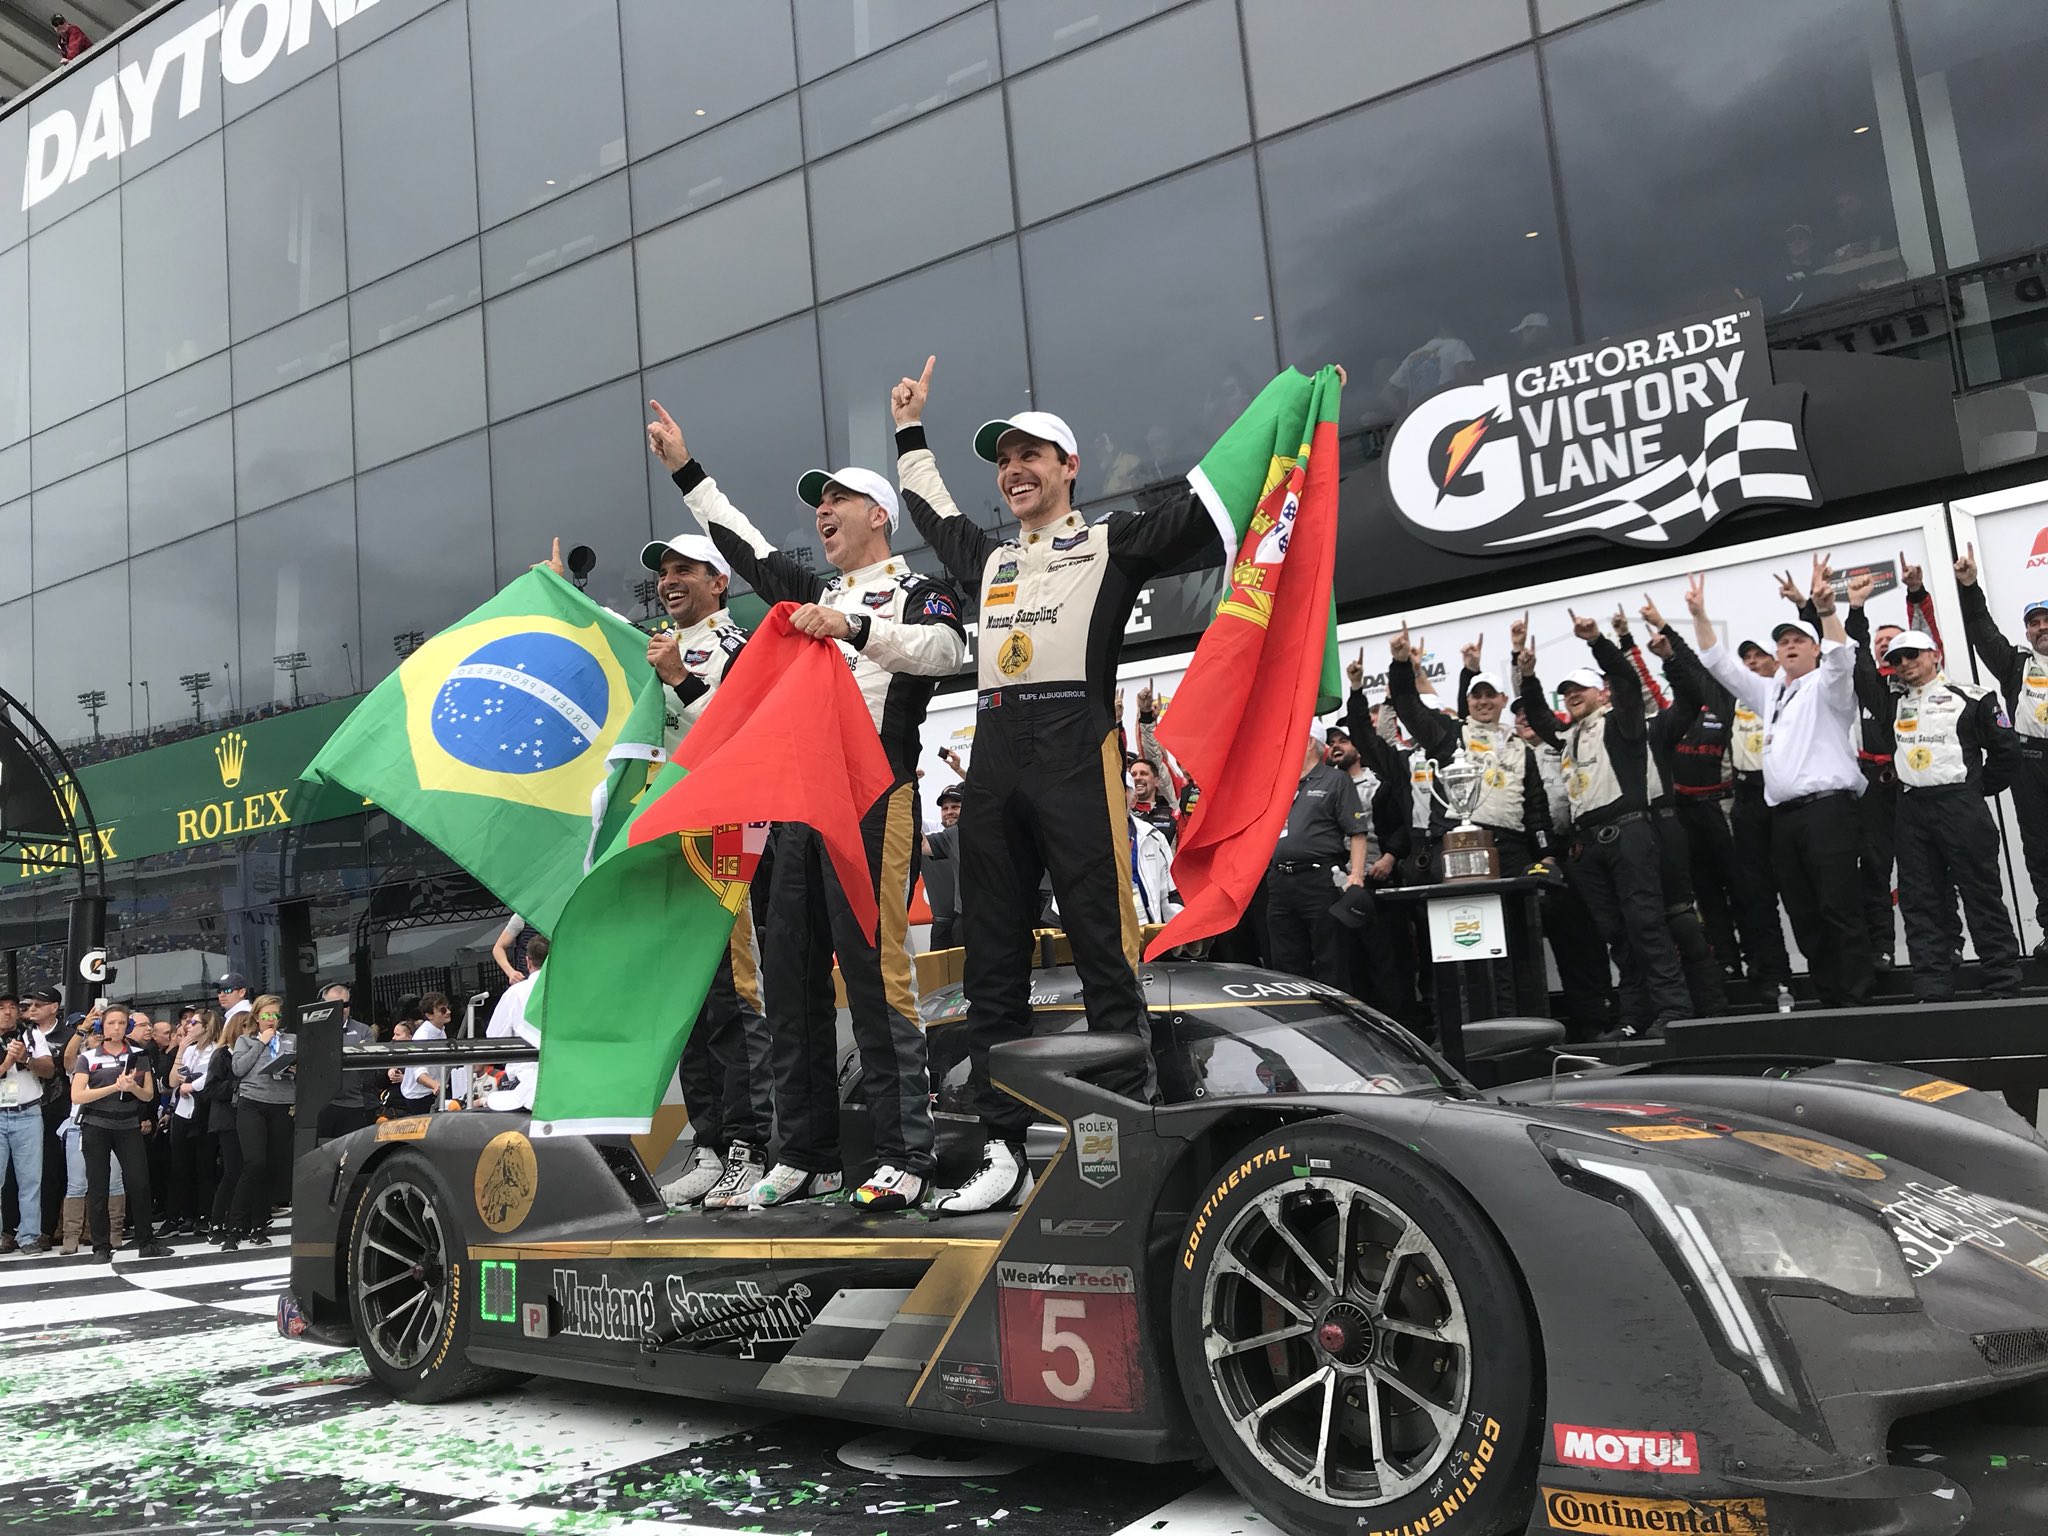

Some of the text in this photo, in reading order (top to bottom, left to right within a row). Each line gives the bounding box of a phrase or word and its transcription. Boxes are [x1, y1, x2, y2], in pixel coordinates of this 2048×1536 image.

[1515, 312, 1741, 398] GATORADE
[1518, 350, 1745, 448] VICTORY
[1530, 423, 1666, 498] LANE
[986, 606, 1059, 630] Mustang Sampling
[1018, 690, 1086, 701] FILIPE ALBUQUERQUE
[177, 789, 291, 844] ROLEX
[1079, 1122, 1113, 1132] ROLEX
[1082, 1136, 1114, 1154] 24
[1084, 1164, 1116, 1173] DAYTONA
[1184, 1145, 1292, 1271] CONTINENTAL
[1001, 1267, 1126, 1287] WeatherTech
[431, 1263, 460, 1370] CONTINENTAL
[529, 1307, 541, 1332] P
[553, 1268, 815, 1360] Mustang Sampling
[1041, 1298, 1096, 1402] 5
[1563, 1430, 1692, 1467] MOTUL
[1549, 1493, 1732, 1534] Continental
